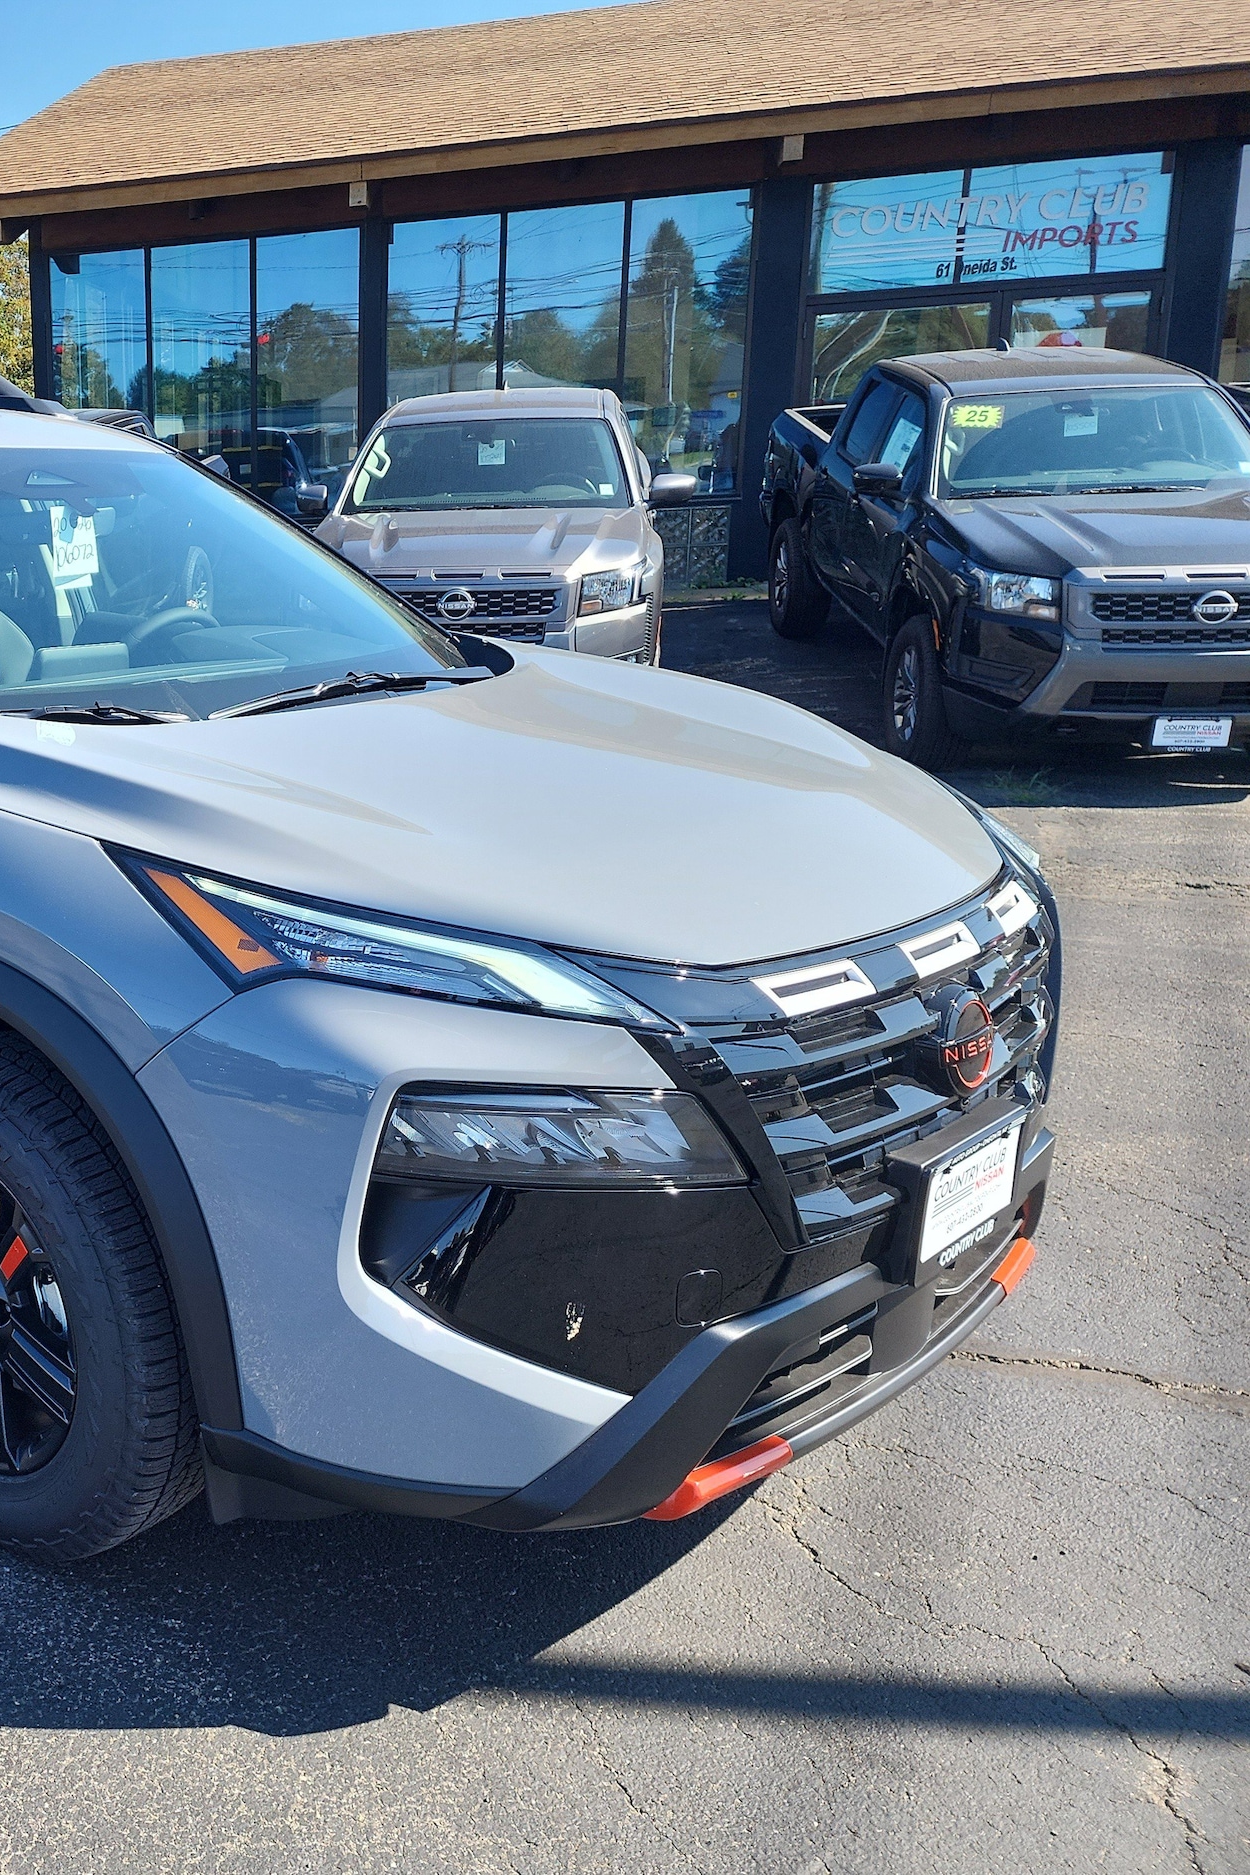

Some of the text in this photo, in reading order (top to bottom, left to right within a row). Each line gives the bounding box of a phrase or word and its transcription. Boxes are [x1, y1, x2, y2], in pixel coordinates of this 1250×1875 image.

[831, 181, 1150, 238] COUNTRY CLUB
[1002, 220, 1139, 253] IMPORTS
[935, 256, 1017, 278] 61 neida St.
[965, 410, 989, 422] 25
[1193, 604, 1238, 613] NISSAN
[934, 1146, 1007, 1202] COUNTRY CLUB
[975, 1165, 1005, 1190] NISSAN
[939, 1218, 996, 1267] COUNTRY CLUB
